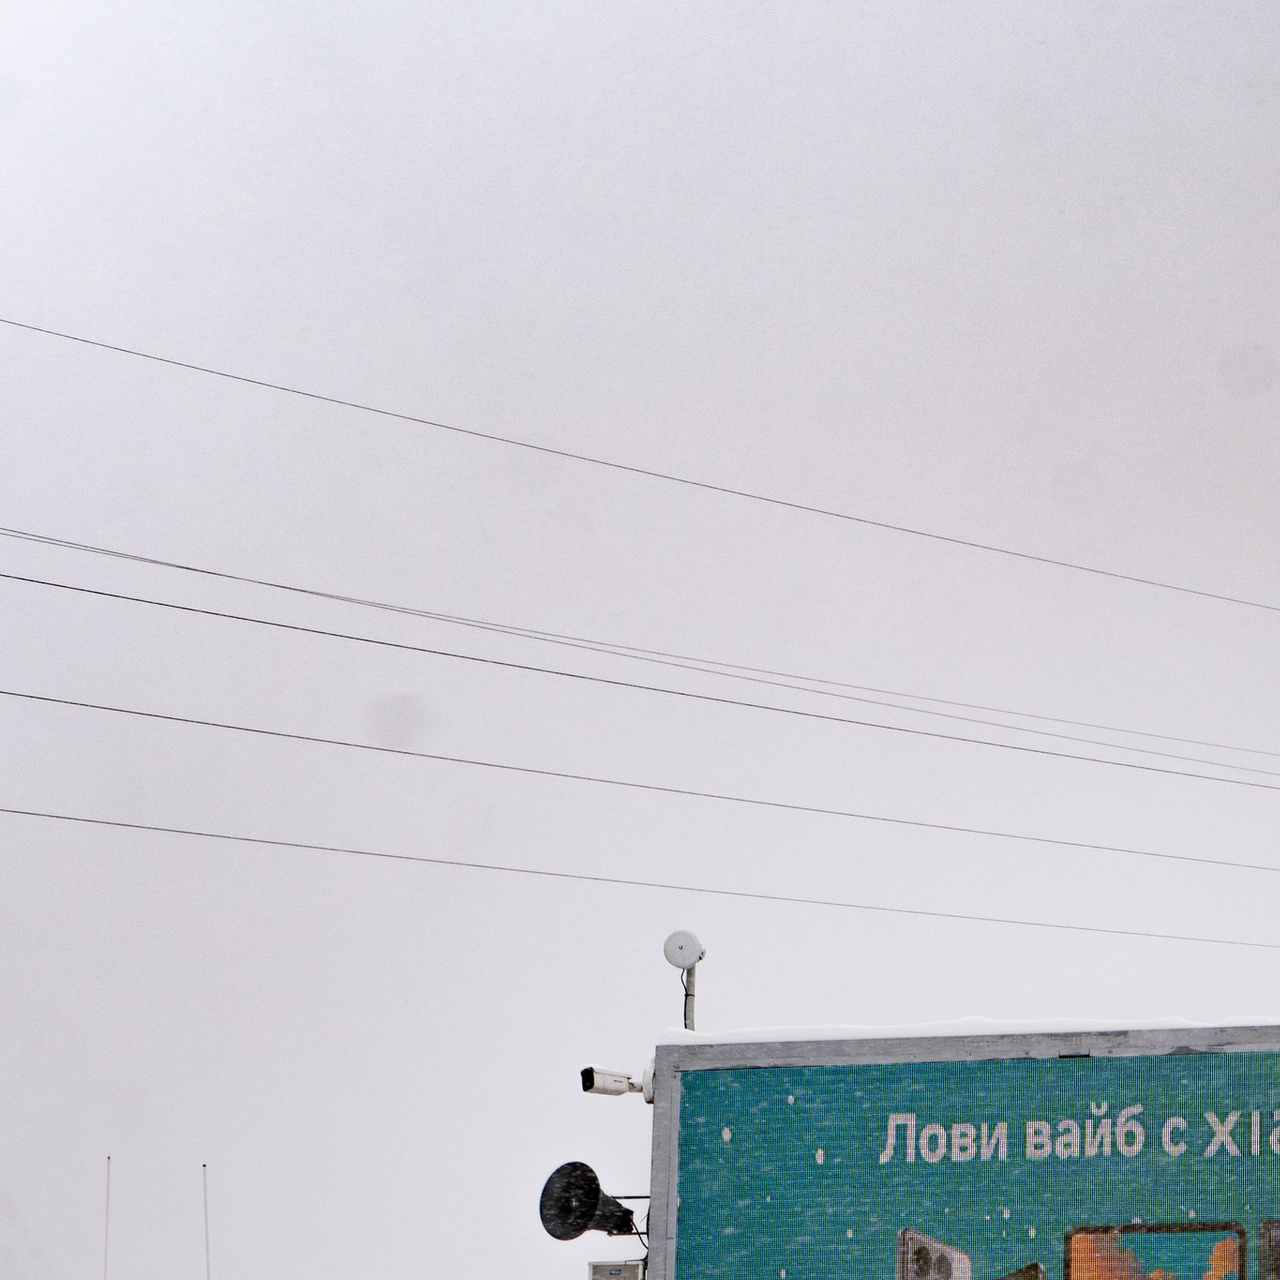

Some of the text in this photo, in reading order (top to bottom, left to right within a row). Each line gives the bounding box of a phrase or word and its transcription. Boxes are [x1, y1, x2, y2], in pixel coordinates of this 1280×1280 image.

[880, 1113, 1007, 1163] Лови
[1026, 1102, 1145, 1159] вайб
[1162, 1117, 1188, 1155] с
